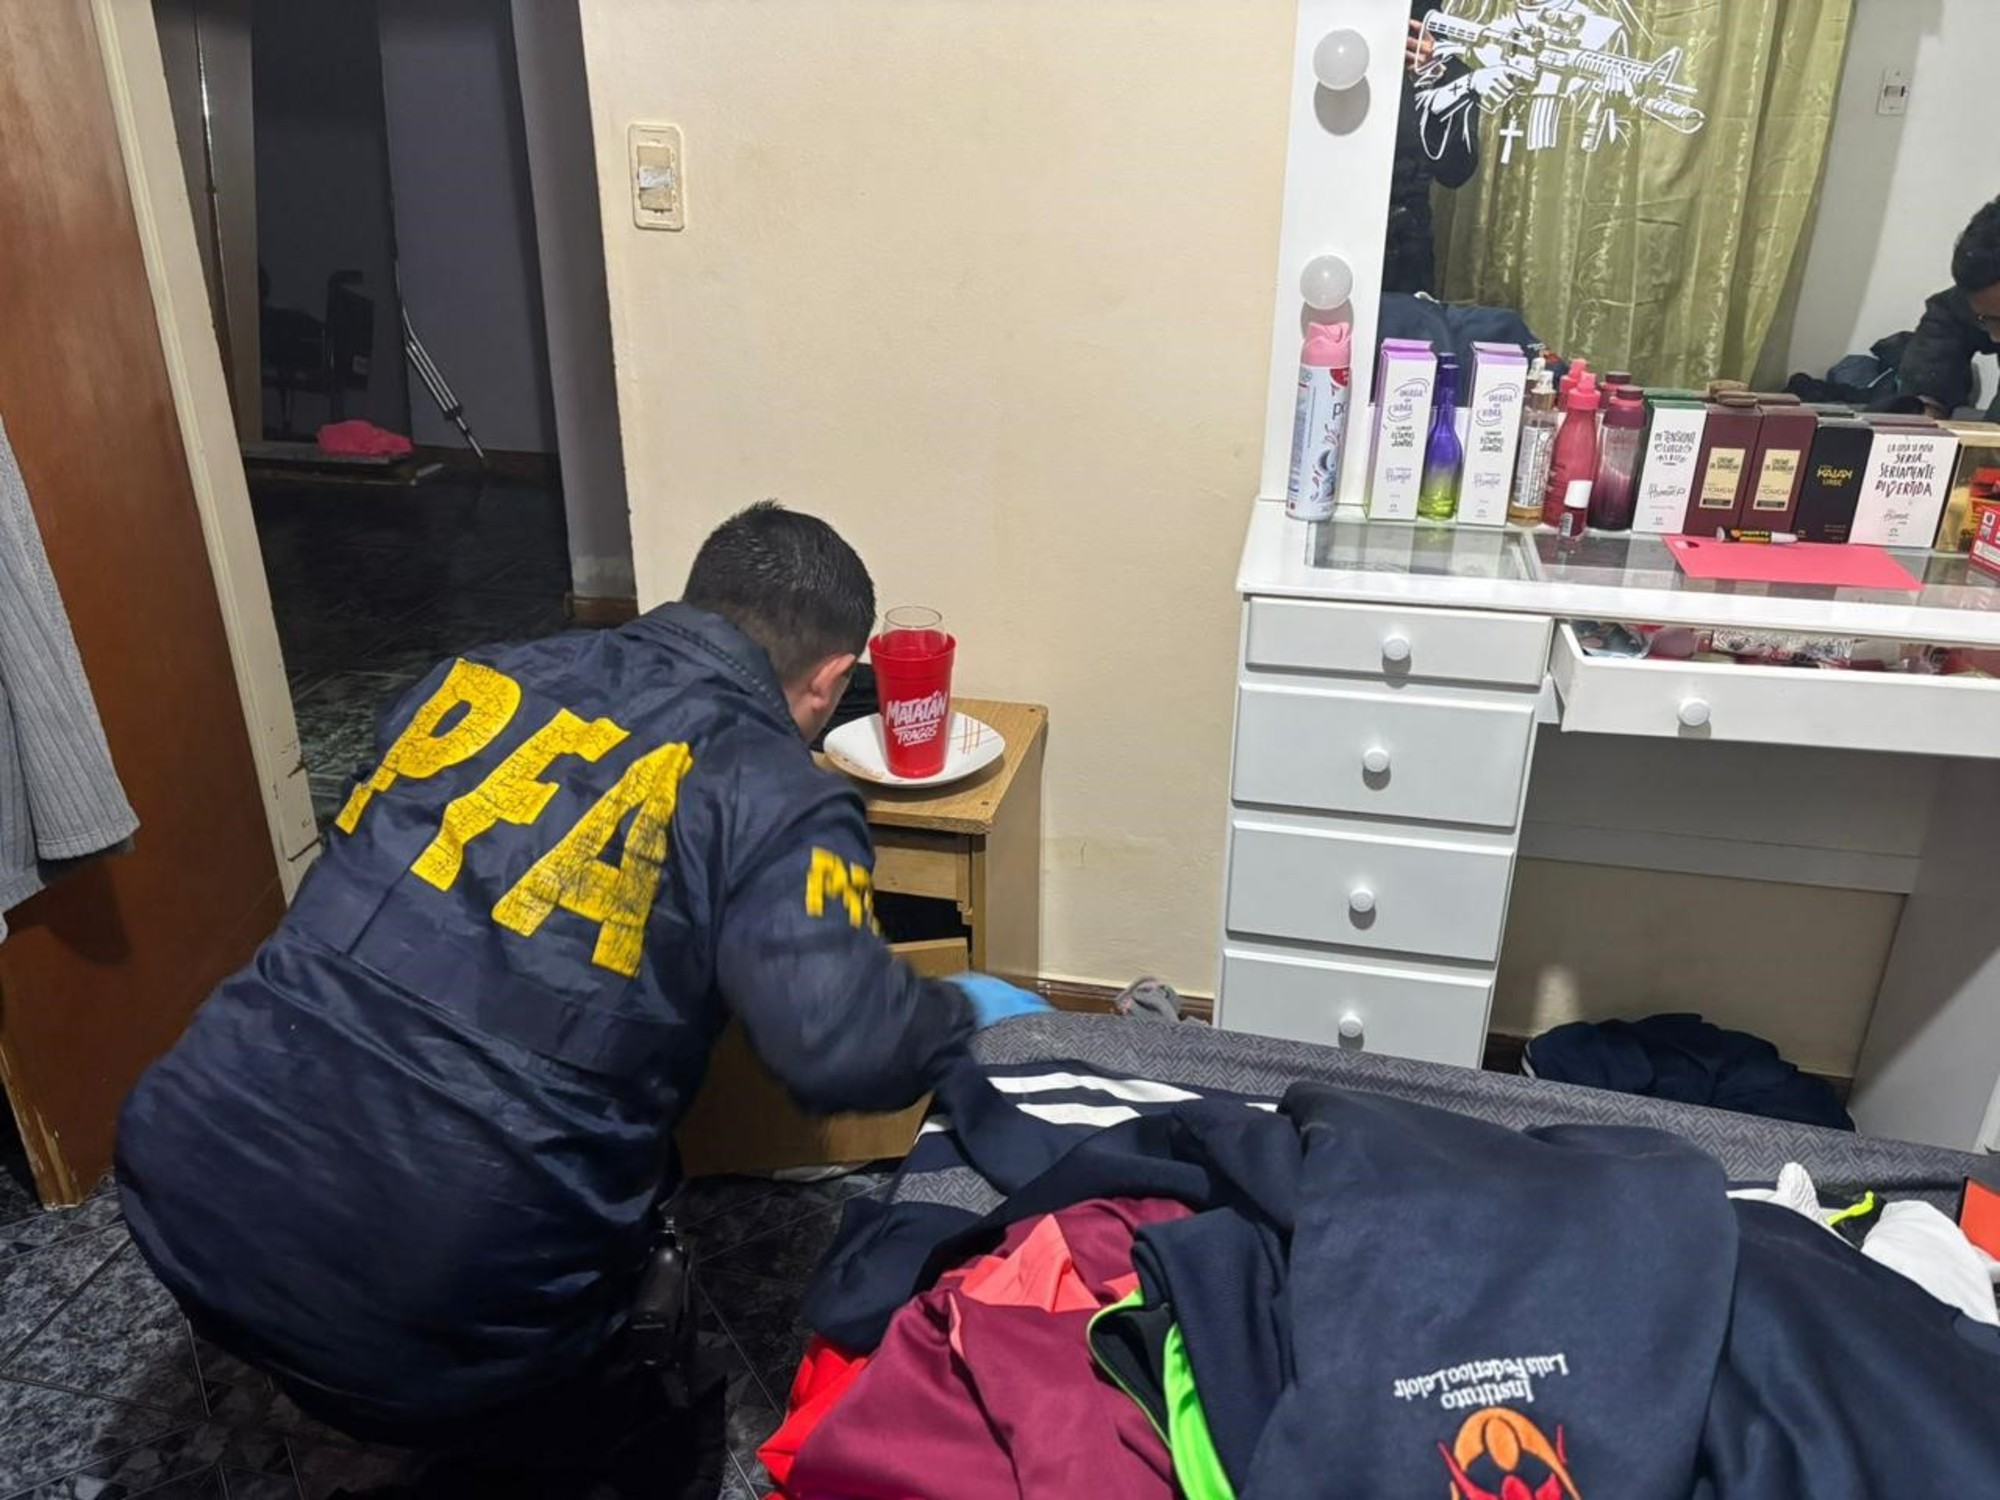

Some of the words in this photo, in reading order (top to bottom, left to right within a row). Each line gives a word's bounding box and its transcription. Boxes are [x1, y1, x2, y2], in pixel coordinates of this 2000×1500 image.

[1879, 462, 1936, 480] SERIAMENTE
[1875, 480, 1932, 498] DIVERTIDA
[895, 723, 938, 745] TRAGOS
[335, 657, 693, 978] PFA
[1450, 1357, 1526, 1383] Federico
[1525, 1353, 1569, 1377] Luis
[1393, 1369, 1450, 1400] Leloir
[1440, 1378, 1535, 1409] Instituto
